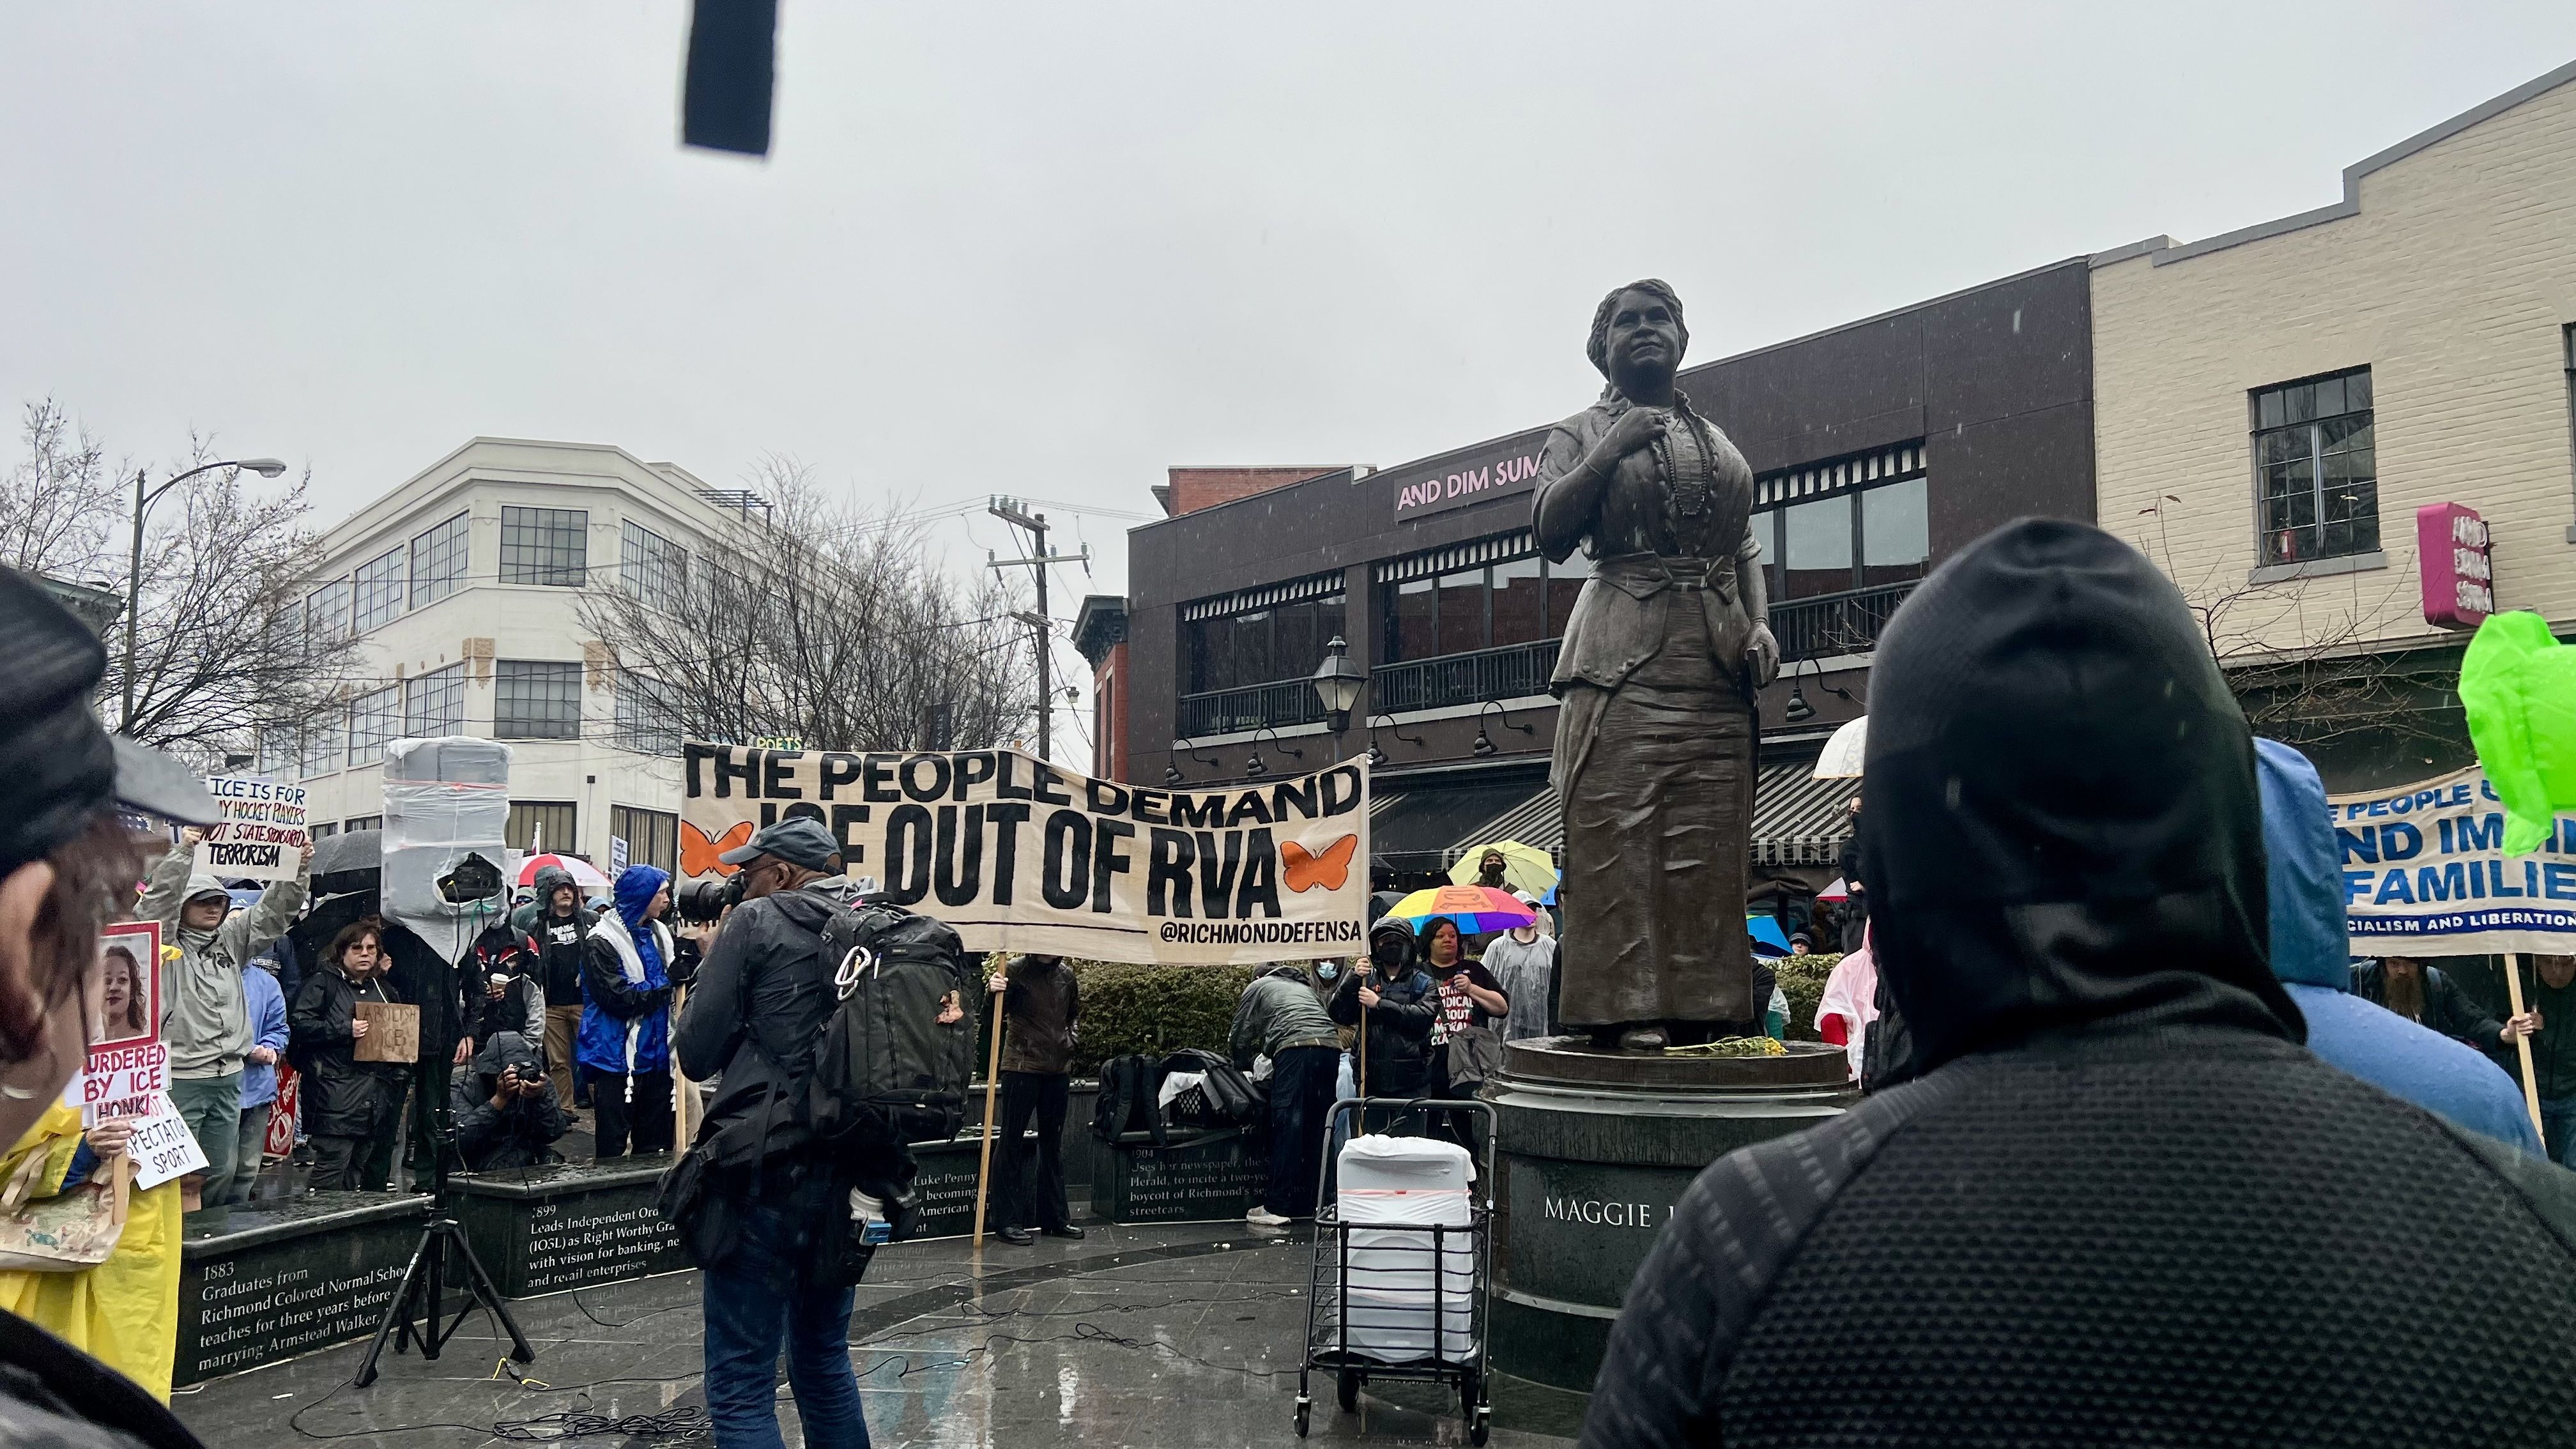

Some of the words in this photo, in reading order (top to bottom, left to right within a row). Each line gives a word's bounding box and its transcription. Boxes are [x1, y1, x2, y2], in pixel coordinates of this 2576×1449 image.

[1397, 480, 1441, 511] AND
[1447, 466, 1490, 499] DIM
[756, 737, 802, 750] POETS
[210, 778, 247, 797] ICE
[249, 783, 270, 800] IS
[276, 786, 305, 805] FOR
[684, 744, 805, 799] THE
[820, 751, 1071, 806] PEOPLE
[1086, 764, 1362, 828] DEMAND
[234, 801, 272, 821] HOCKEY
[273, 802, 305, 825] PLAYERS
[2347, 785, 2472, 820] PEOPLE
[200, 823, 230, 841] NOT
[233, 823, 267, 841] STATE
[208, 843, 280, 867] TERRORISM
[884, 802, 1030, 907] OUT
[1042, 809, 1135, 913] OF
[1147, 827, 1282, 919] RVA
[2343, 860, 2576, 906] FAMILIE
[1160, 920, 1362, 944] @RICHMONDDEFENSA
[2427, 916, 2464, 930] AND
[364, 1006, 416, 1023] ABOLISH
[84, 1074, 114, 1102] BY
[130, 1066, 161, 1093] ICE
[153, 1145, 191, 1174] SPORT
[914, 1174, 940, 1186] Luke
[945, 1173, 977, 1184] Penny
[1130, 1176, 1170, 1187] Herald,
[1174, 1176, 1185, 1184] to
[1188, 1174, 1218, 1184] incite
[926, 1188, 977, 1200] becoming
[1130, 1190, 1170, 1204] boycott
[1173, 1189, 1185, 1199] of
[1189, 1186, 1250, 1199] Richmond's
[531, 1220, 564, 1234] Leads
[567, 1210, 635, 1230] Independent
[918, 1204, 969, 1216] American
[1130, 1206, 1185, 1216] streetcars
[1545, 1196, 1651, 1228] MAGGIE
[529, 1237, 566, 1255] (IOSL)
[568, 1238, 579, 1246] as
[583, 1230, 613, 1245] Right
[617, 1224, 655, 1239] Worthy
[529, 1255, 555, 1270] with
[560, 1250, 594, 1264] vision
[598, 1247, 615, 1259] for
[618, 1240, 664, 1254] banking,
[203, 1278, 272, 1301] Graduates
[277, 1268, 308, 1285] from
[204, 1262, 234, 1282] 1883
[528, 1273, 549, 1288] and
[586, 1259, 647, 1278] enterprises
[202, 1296, 271, 1325] Richmond
[275, 1281, 324, 1307] Colored
[328, 1271, 374, 1294] Normal
[200, 1326, 251, 1348] teaches
[256, 1319, 275, 1334] for
[280, 1310, 312, 1328] three
[318, 1299, 349, 1322] years
[354, 1291, 390, 1308] before
[199, 1344, 263, 1371] marrying
[269, 1323, 330, 1353] Armstead
[336, 1313, 380, 1334] Walker,
